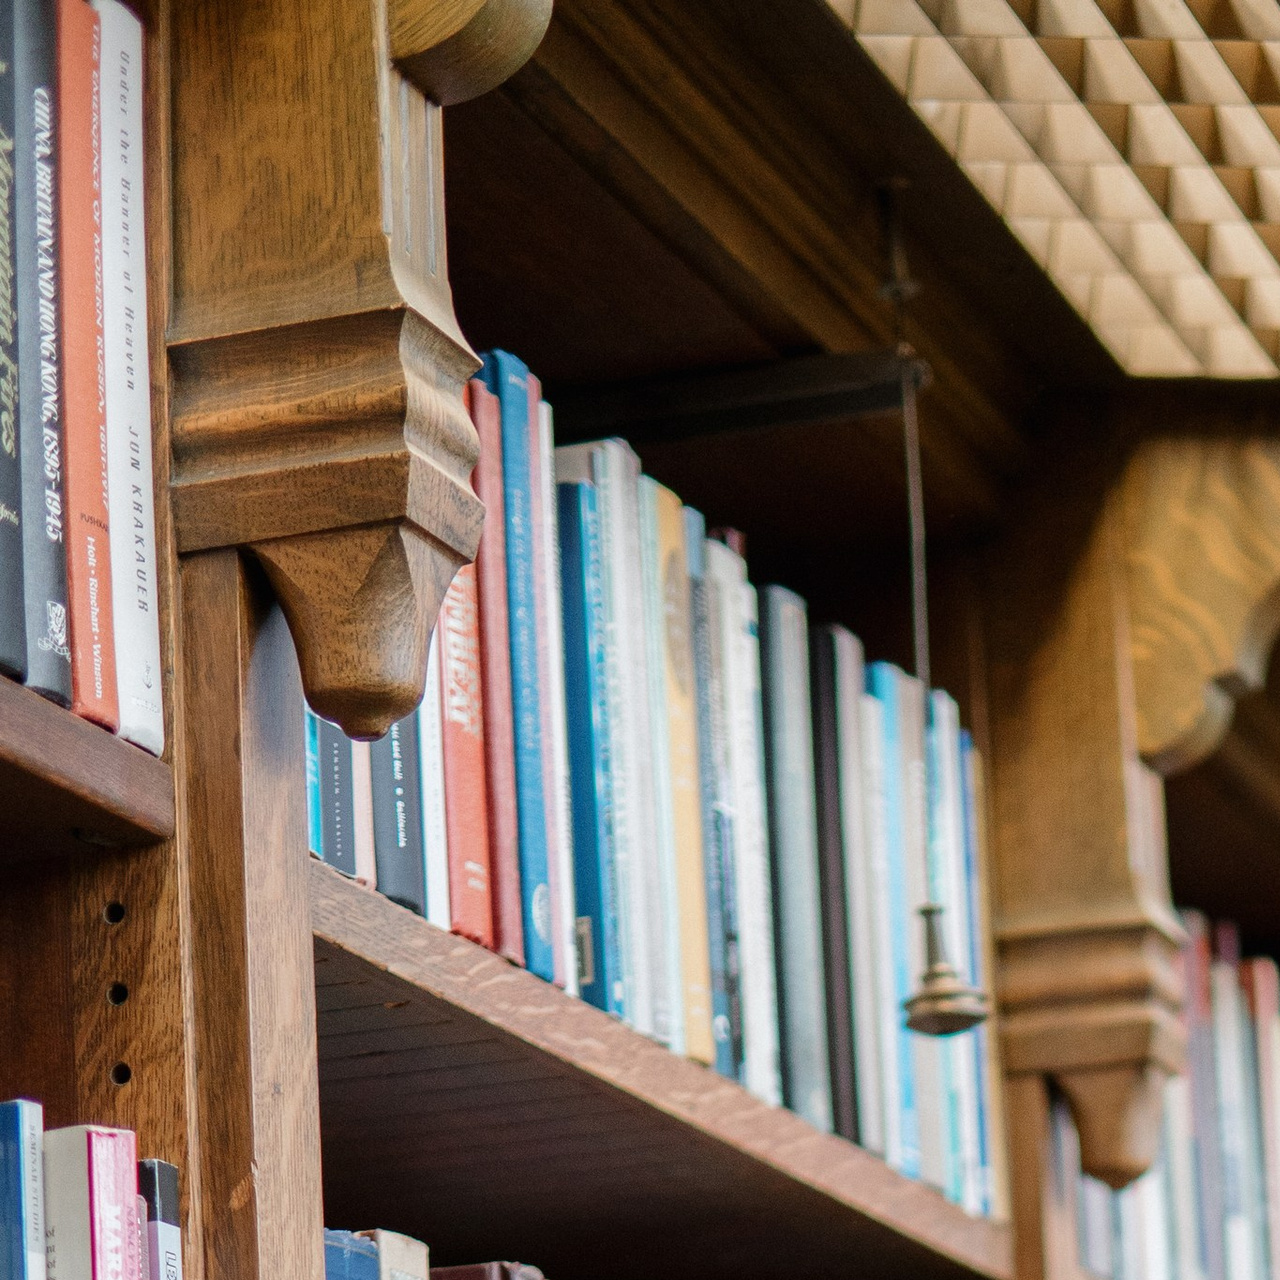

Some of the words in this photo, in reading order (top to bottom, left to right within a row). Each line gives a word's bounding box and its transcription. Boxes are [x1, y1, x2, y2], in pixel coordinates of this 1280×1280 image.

[119, 51, 130, 115] Under
[33, 87, 51, 158] CHINA,
[92, 70, 102, 190] EMERGENCE
[119, 129, 131, 164] the
[35, 160, 54, 249] BRITAIN
[92, 202, 102, 225] OF
[120, 178, 132, 257] Banner
[37, 250, 56, 298] AND
[92, 231, 104, 327] MODERN
[123, 272, 134, 294] of
[39, 298, 58, 360] HONG
[124, 306, 136, 390] Heaven
[40, 360, 59, 423] KONG,
[127, 426, 141, 471] JON
[42, 427, 64, 543] 1895-1945
[86, 536, 98, 567] Holt
[131, 483, 149, 612] KRAKAUER
[88, 577, 101, 633] Rinehart
[92, 643, 103, 699] Winston
[30, 1124, 38, 1184] SEMINAR
[32, 1188, 40, 1243] STUDIES
